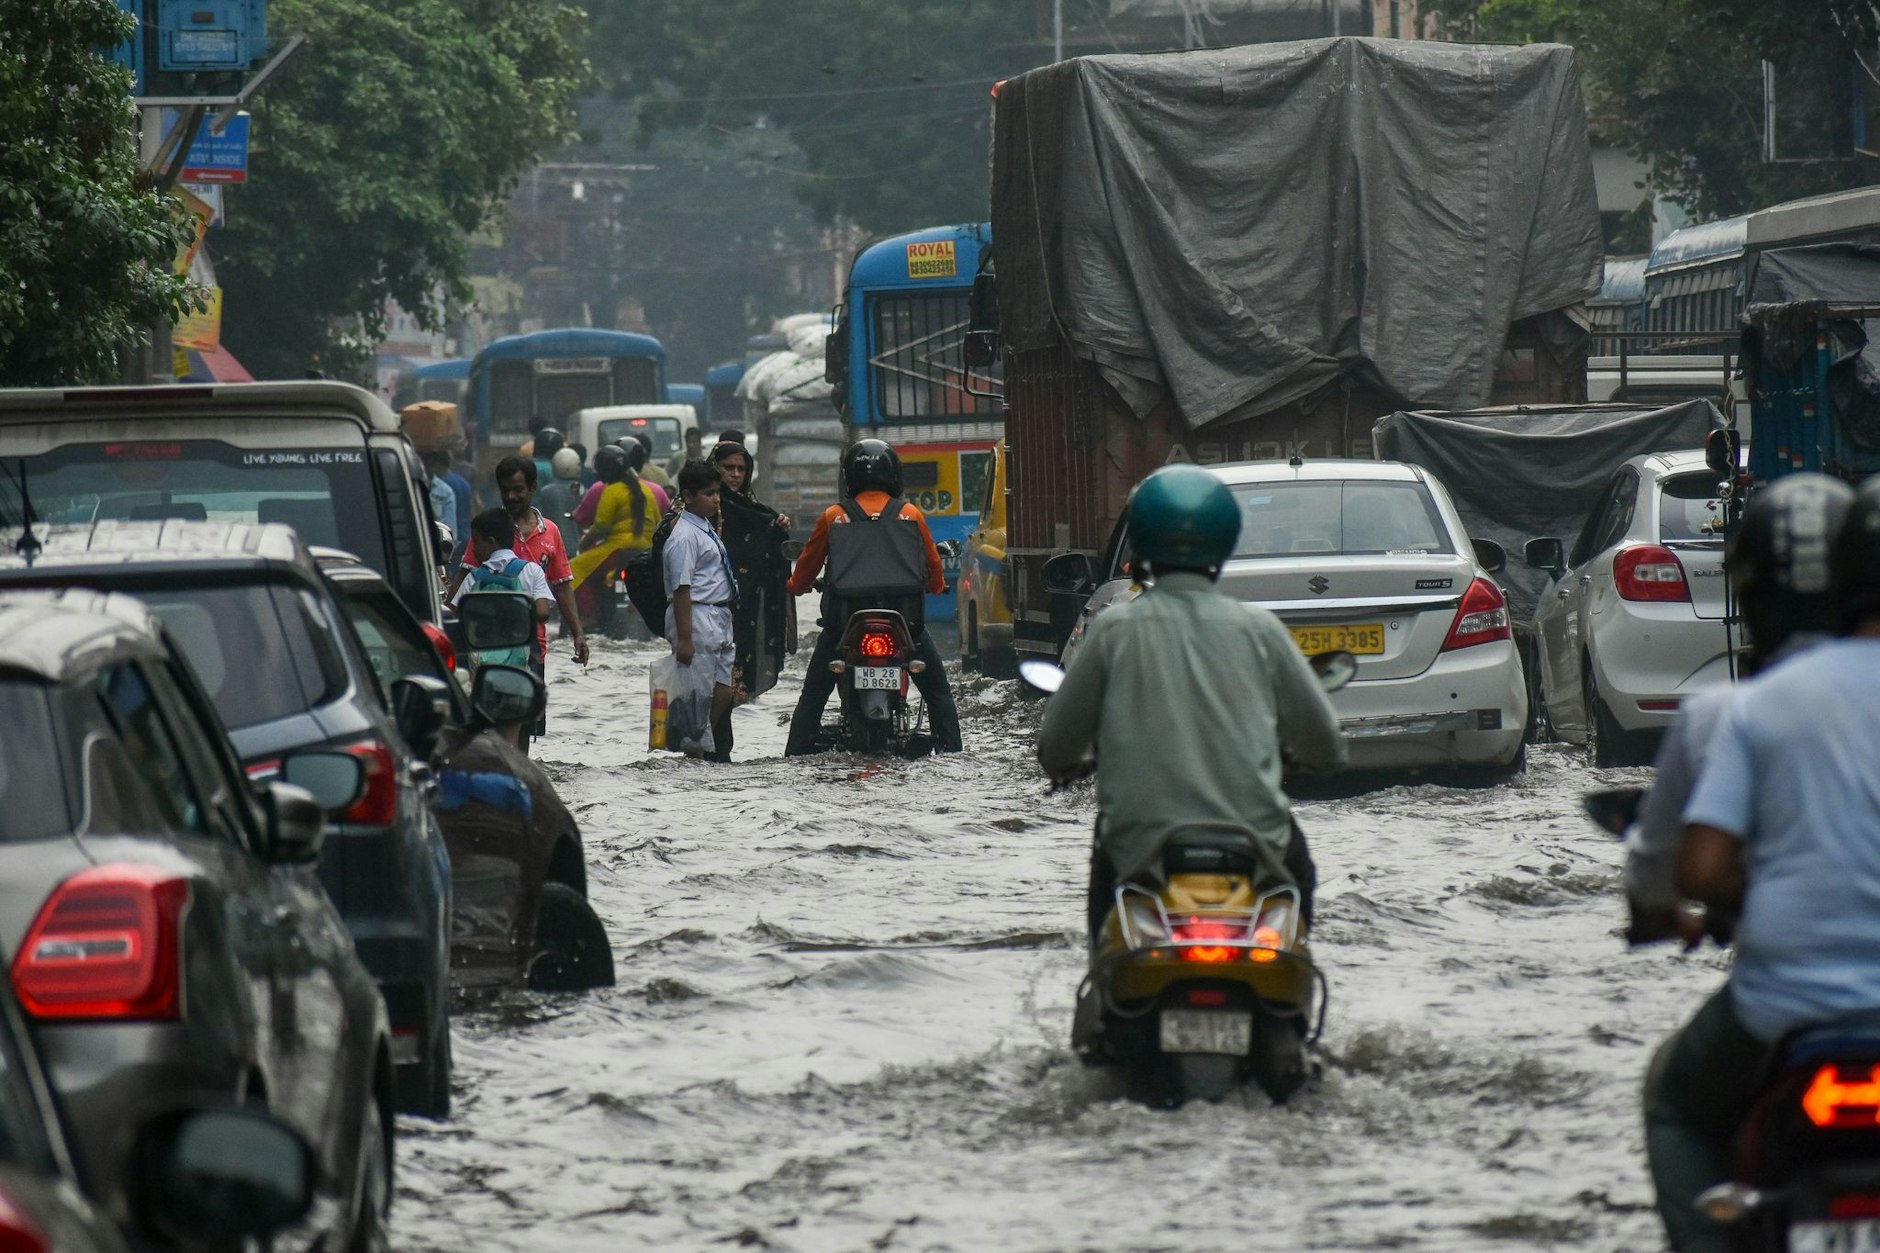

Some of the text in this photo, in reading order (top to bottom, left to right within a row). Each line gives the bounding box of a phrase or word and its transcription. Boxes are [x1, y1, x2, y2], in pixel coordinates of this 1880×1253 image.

[909, 242, 953, 257] ROYAL
[1326, 439, 1373, 459] LE
[243, 452, 362, 464] LIVE YOUNG LIVE FREE
[904, 489, 953, 513] TOP
[1441, 580, 1451, 588] S
[1299, 631, 1380, 650] 25H 3385
[863, 668, 895, 678] WB 28
[862, 678, 898, 688] D 8628
